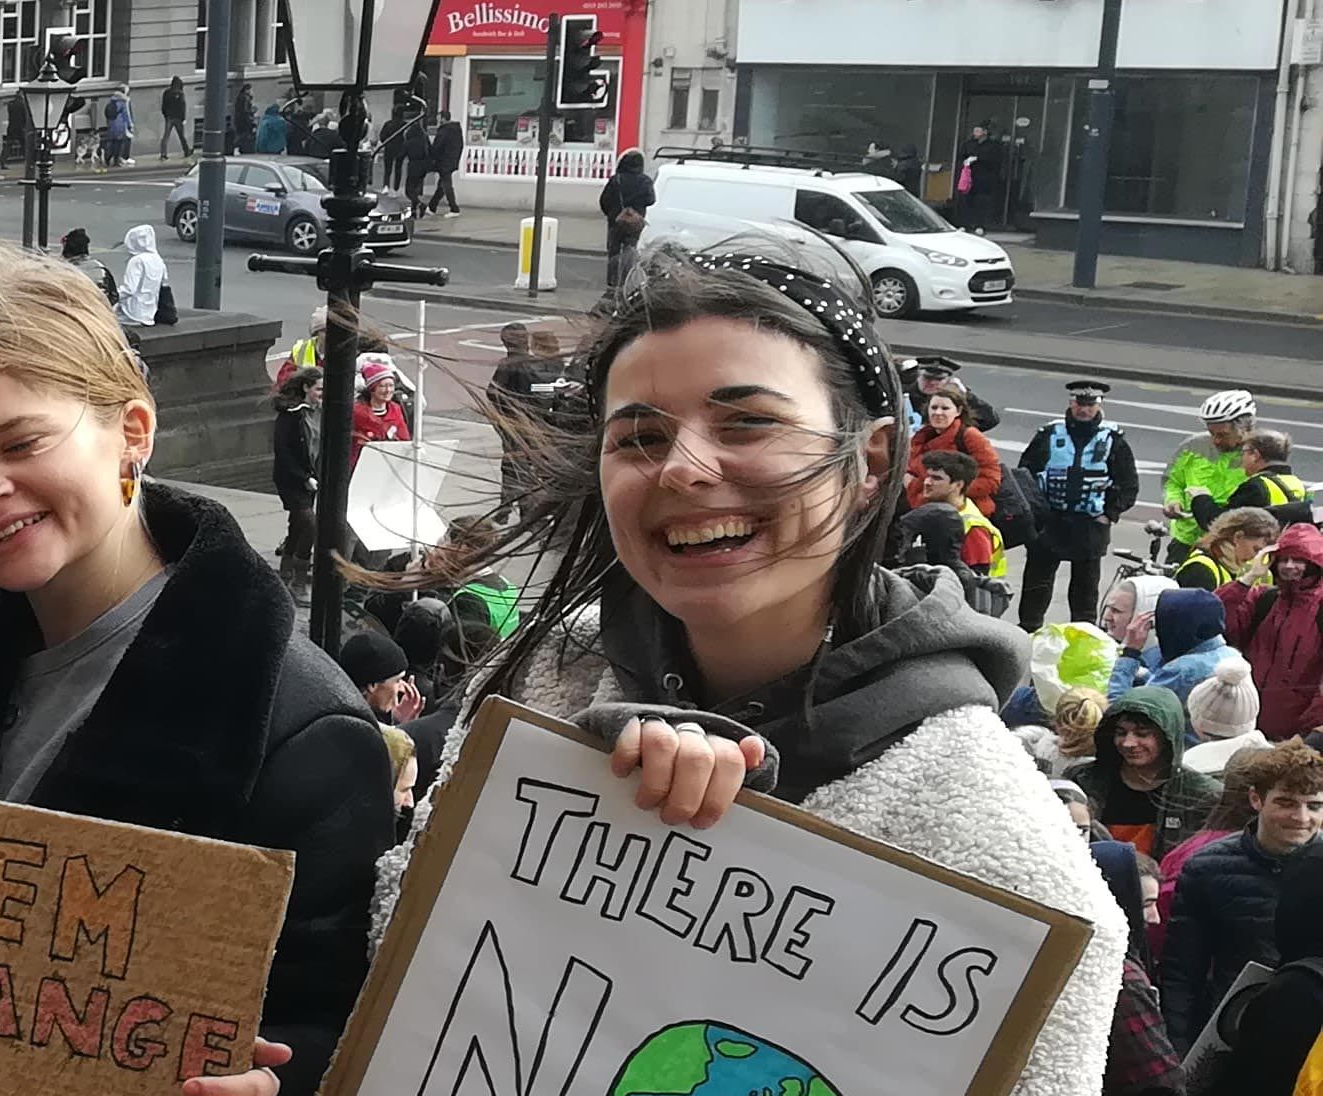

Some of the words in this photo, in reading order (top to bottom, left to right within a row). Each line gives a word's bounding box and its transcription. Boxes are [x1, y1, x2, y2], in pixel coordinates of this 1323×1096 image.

[447, 2, 550, 34] Bellissimo
[510, 777, 835, 981] THERE
[855, 917, 998, 1036] IS
